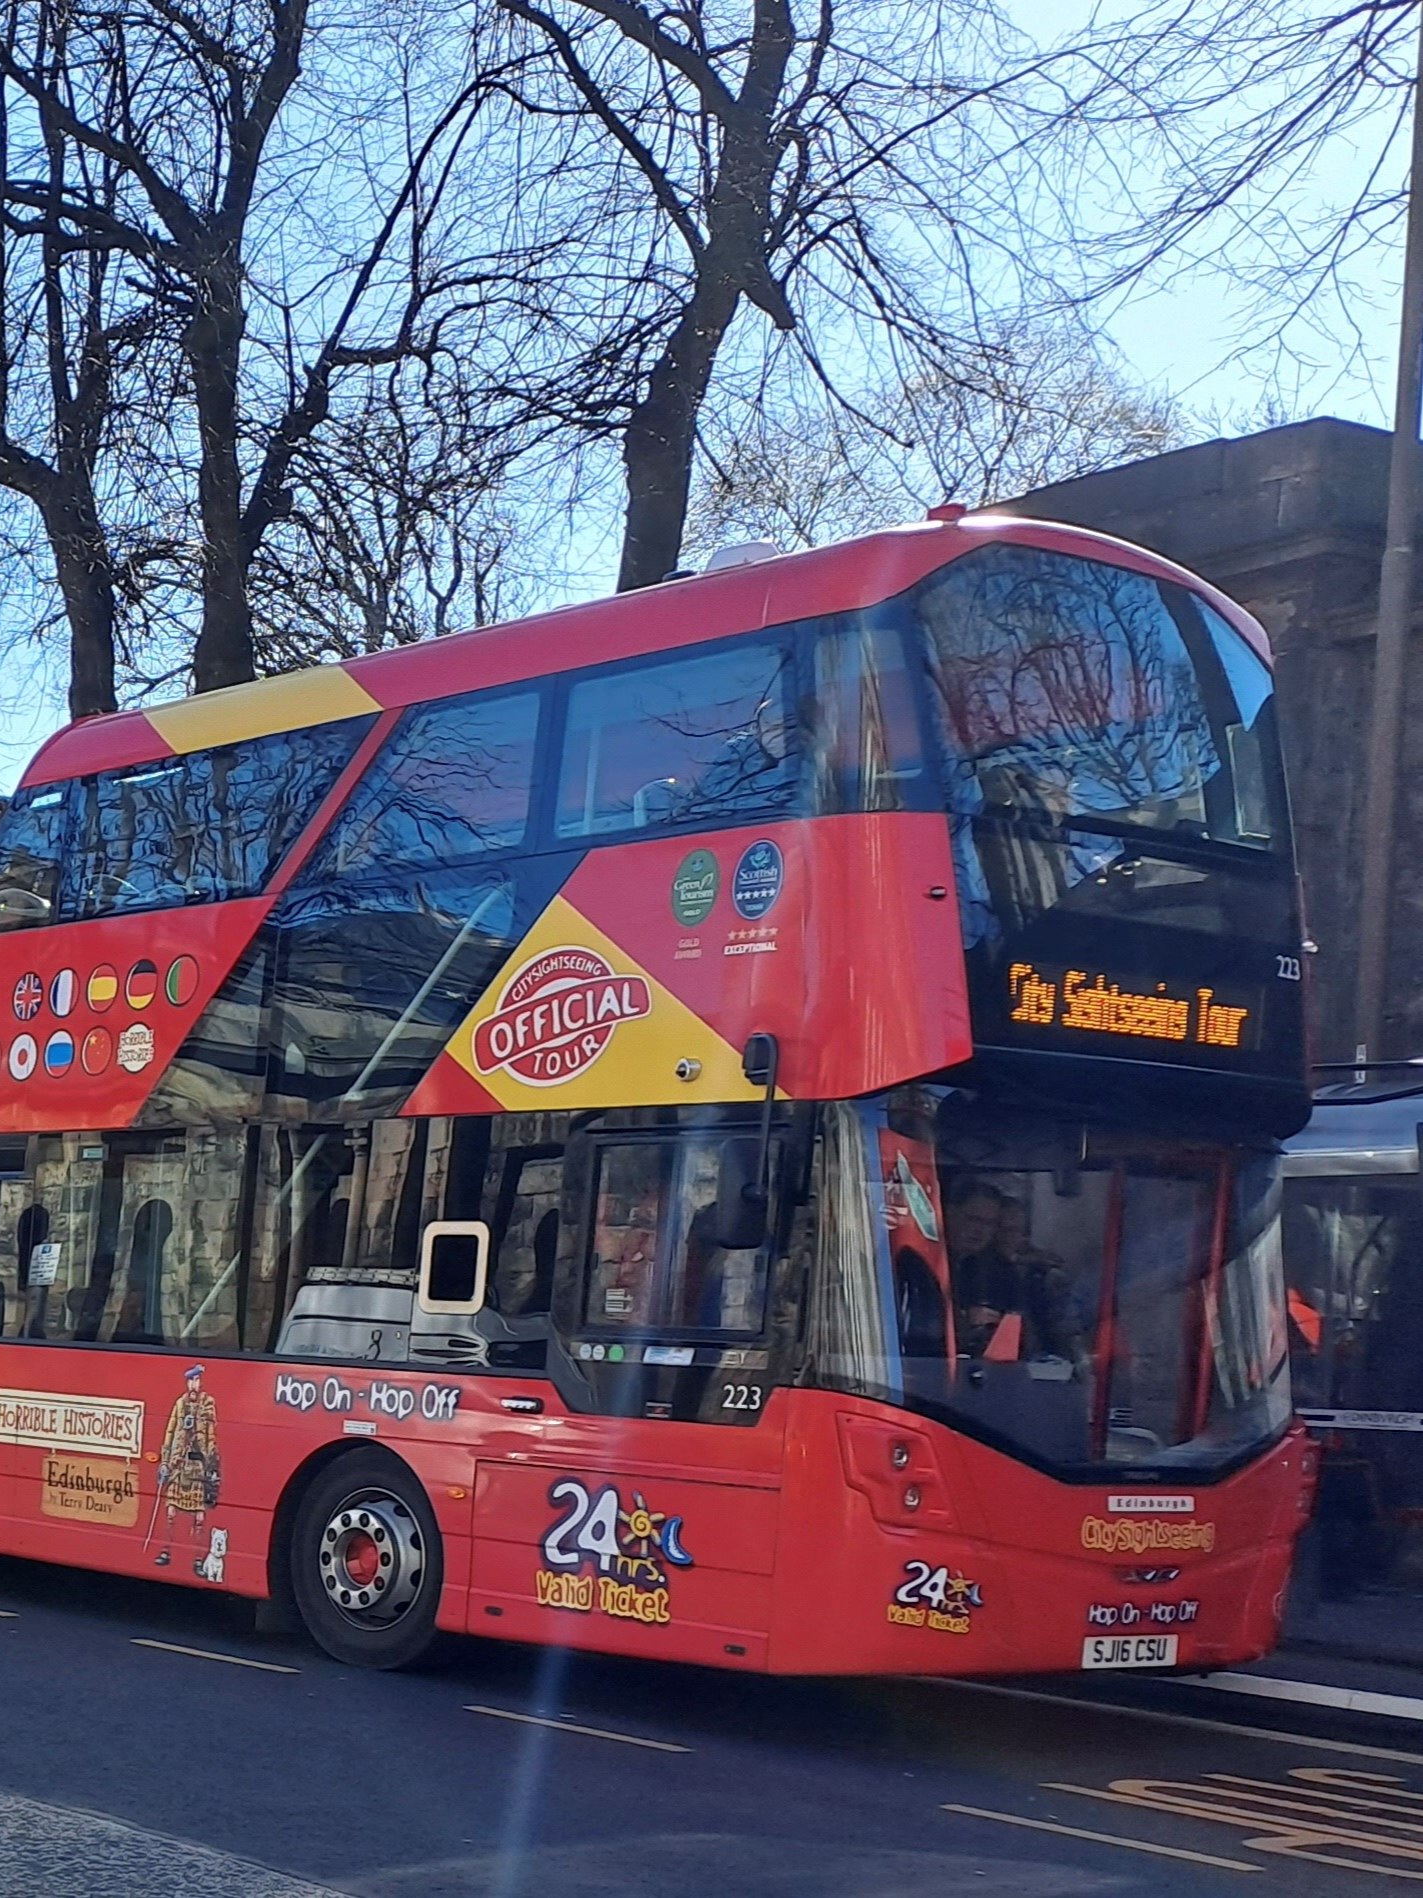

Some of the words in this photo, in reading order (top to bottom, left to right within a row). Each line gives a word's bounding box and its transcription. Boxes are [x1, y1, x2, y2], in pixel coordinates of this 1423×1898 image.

[511, 955, 603, 1001] CITYSIGHTSEEING
[1276, 955, 1301, 981] 223
[489, 981, 641, 1059] OFFICIAL
[533, 1034, 600, 1076] TOUR
[275, 1375, 317, 1411] Hop
[322, 1377, 352, 1410] On
[369, 1381, 414, 1420] Hop
[421, 1384, 460, 1419] Off
[722, 1384, 762, 1410] 223
[63, 1409, 133, 1442] HISTORIES
[47, 1460, 135, 1504] Edinburgh
[1117, 1498, 1188, 1510] Edinburgh
[544, 1482, 621, 1571] 24
[536, 1570, 593, 1611] Valid
[598, 1577, 671, 1623] Ticket
[895, 1560, 949, 1608] 24
[888, 1604, 926, 1627] Valid
[928, 1609, 970, 1634] Ticket
[1089, 1604, 1118, 1626] Hop
[1122, 1602, 1140, 1624] On
[1151, 1603, 1176, 1624] Hop
[1179, 1600, 1199, 1621] Off
[1093, 1638, 1131, 1663] SJ16
[1135, 1637, 1168, 1662] CSU
